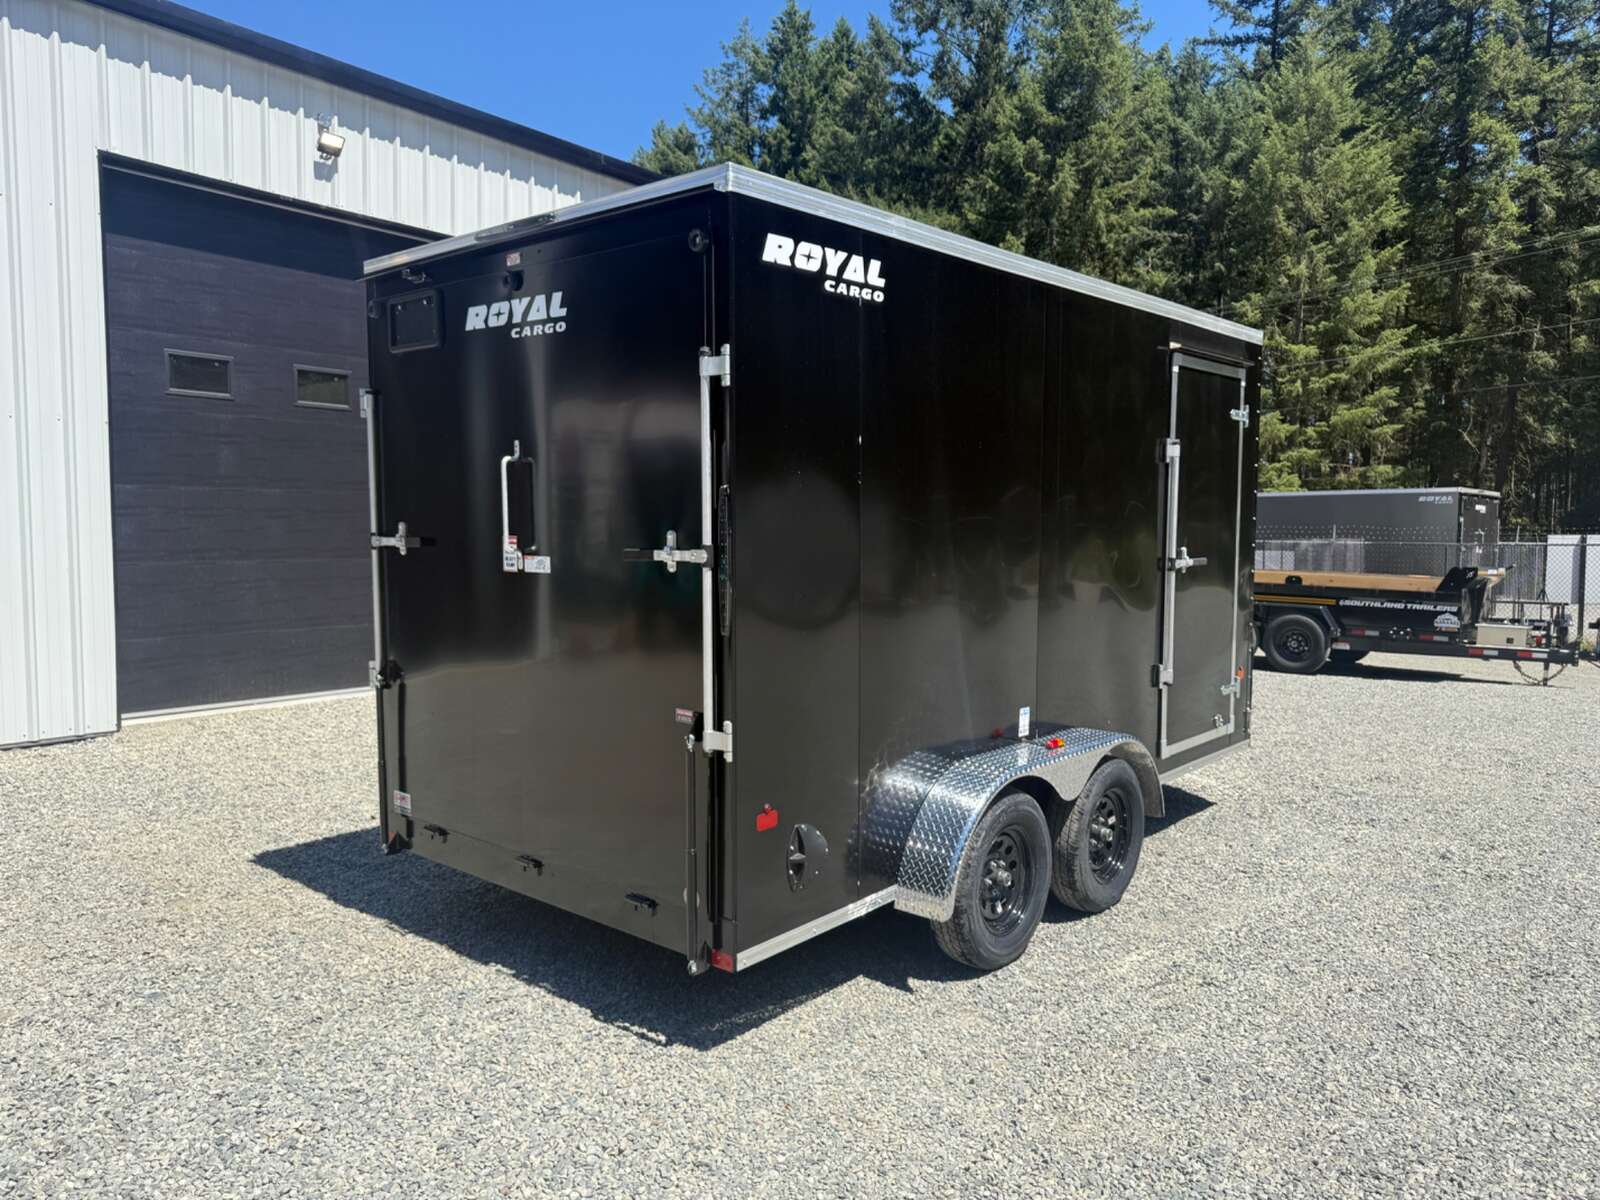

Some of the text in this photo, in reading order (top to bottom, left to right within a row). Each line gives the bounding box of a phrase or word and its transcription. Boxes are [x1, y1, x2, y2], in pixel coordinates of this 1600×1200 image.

[761, 232, 886, 288] ROYAL
[823, 279, 885, 303] CARGO
[465, 291, 568, 331] ROYAL
[510, 321, 567, 339] CARGO
[1343, 600, 1458, 612] SOUTHLAND TRAILERS
